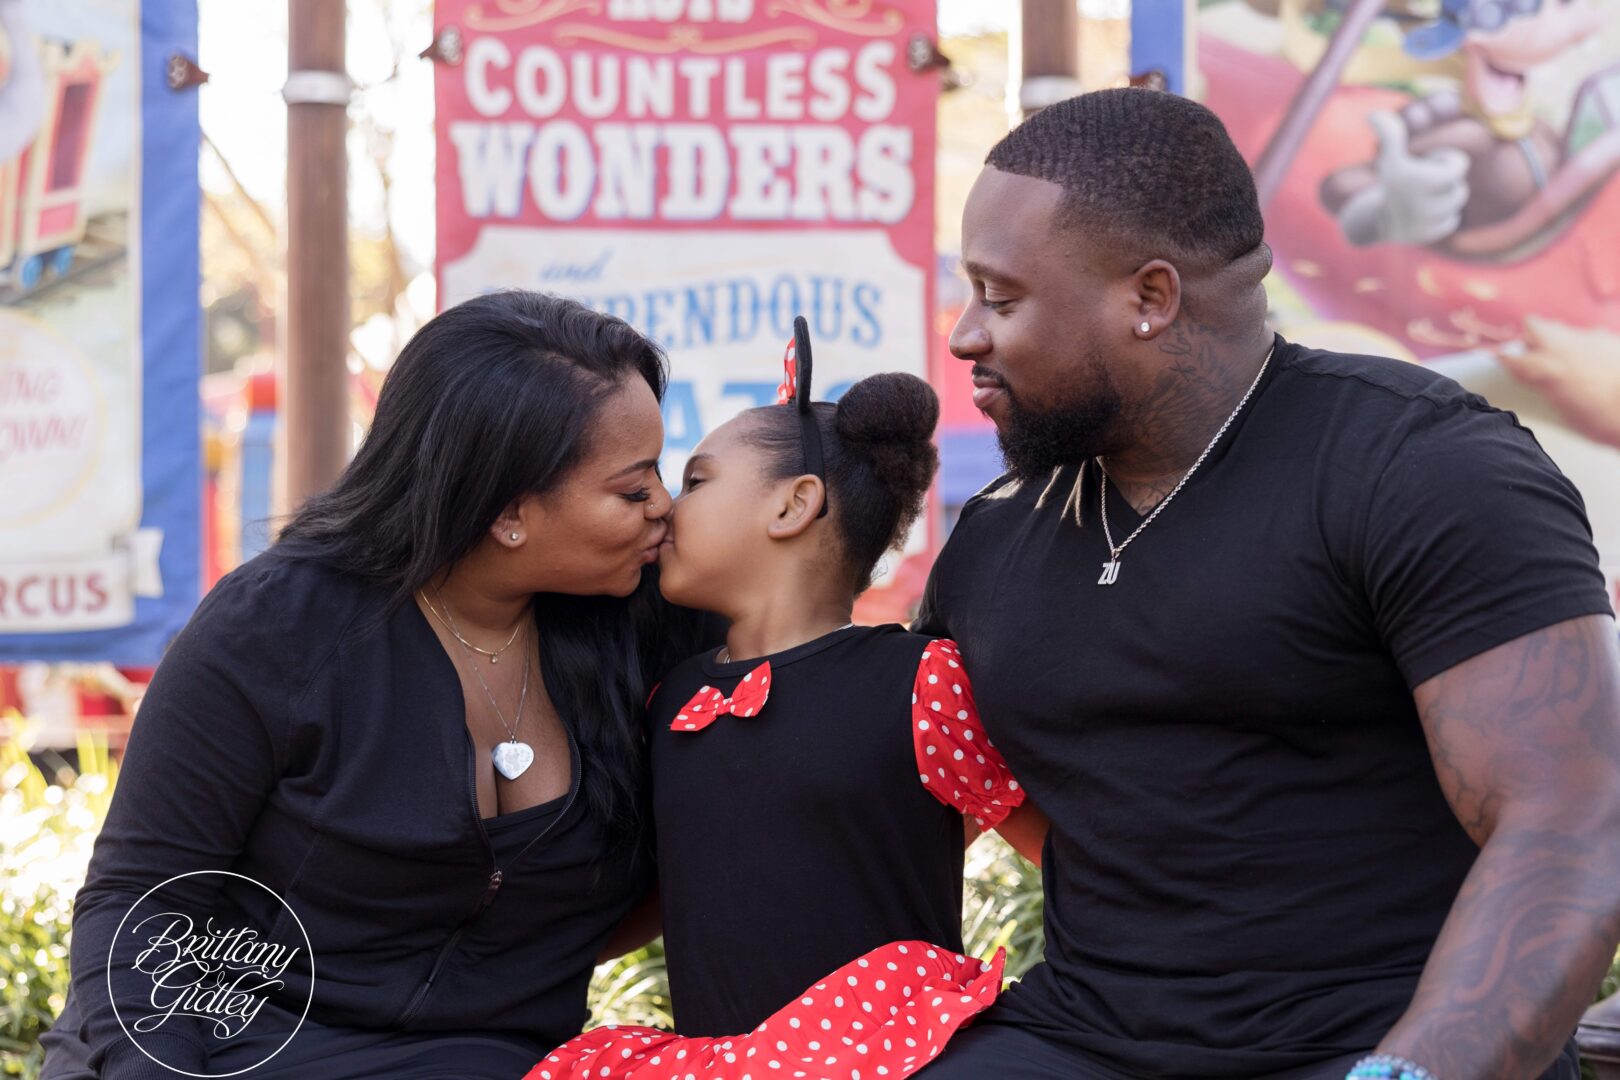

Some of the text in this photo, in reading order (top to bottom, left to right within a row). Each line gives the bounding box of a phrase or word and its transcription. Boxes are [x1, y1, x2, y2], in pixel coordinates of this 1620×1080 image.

[464, 37, 897, 121] COUNTLESS
[449, 119, 916, 224] WONDERS
[540, 249, 613, 283] and
[482, 273, 883, 349] PENDOUS
